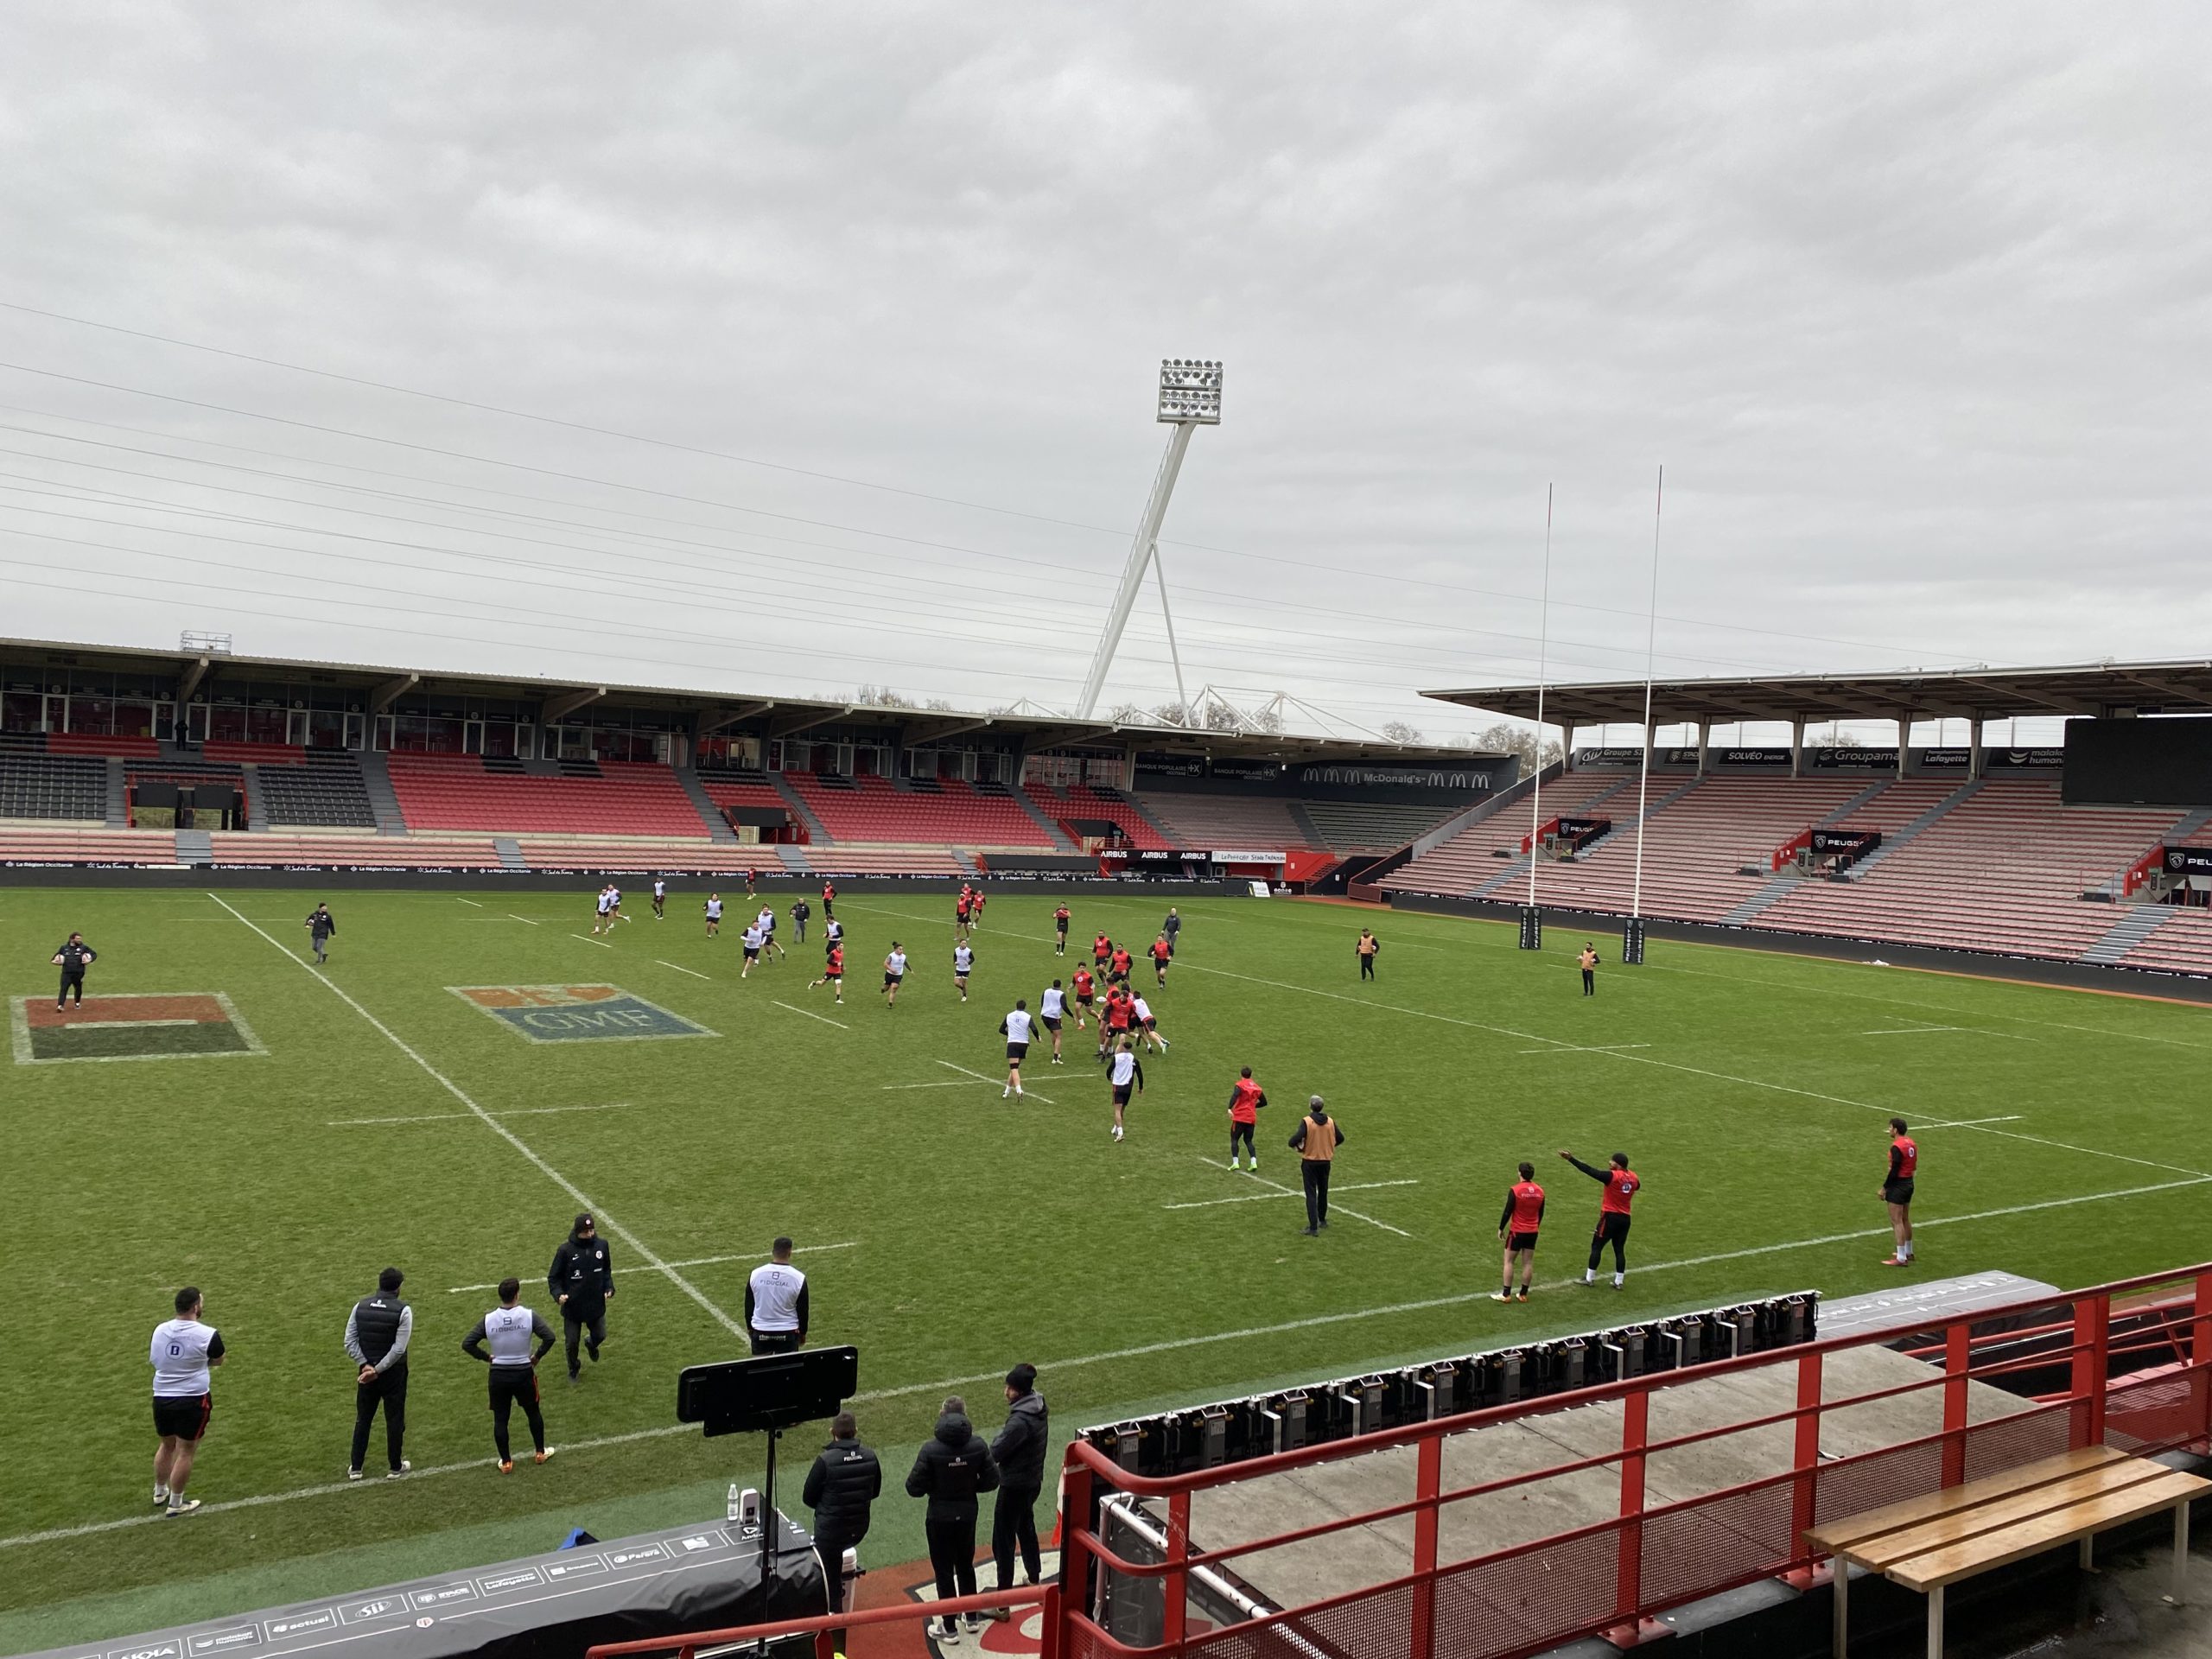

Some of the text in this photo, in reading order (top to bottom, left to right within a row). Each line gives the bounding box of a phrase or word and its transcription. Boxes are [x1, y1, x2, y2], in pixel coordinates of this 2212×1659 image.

[1604, 749, 1631, 758] Groupe
[1728, 751, 1762, 760] SOLVÉO
[1834, 750, 1899, 763] Groupama
[1925, 755, 1967, 764] Lafayette
[1363, 774, 1421, 784] McDonald's
[524, 1009, 654, 1030] GMF
[486, 1576, 536, 1590] Lafayette
[290, 1616, 330, 1630] actual
